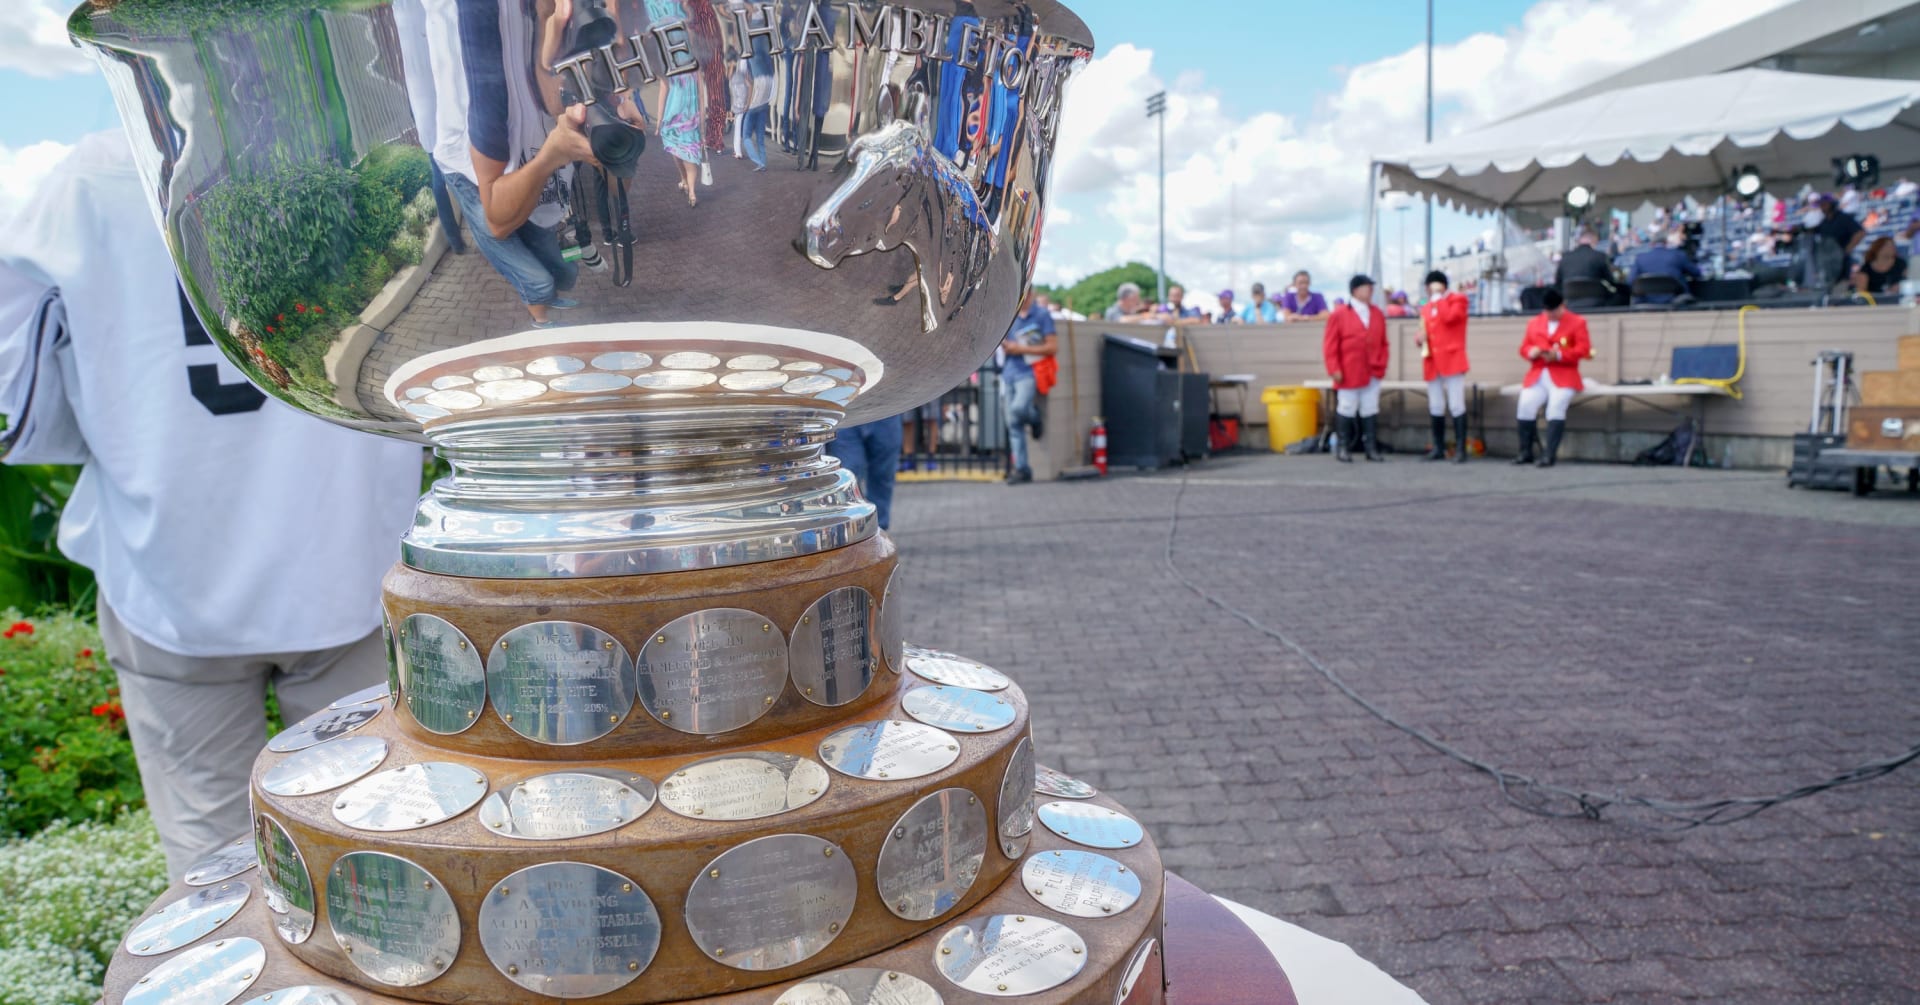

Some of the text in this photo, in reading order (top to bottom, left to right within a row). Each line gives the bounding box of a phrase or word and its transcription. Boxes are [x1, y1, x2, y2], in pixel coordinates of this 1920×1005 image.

[554, 20, 699, 105] THE
[988, 956, 1033, 982] STANLEY
[1031, 943, 1068, 962] DANCER
